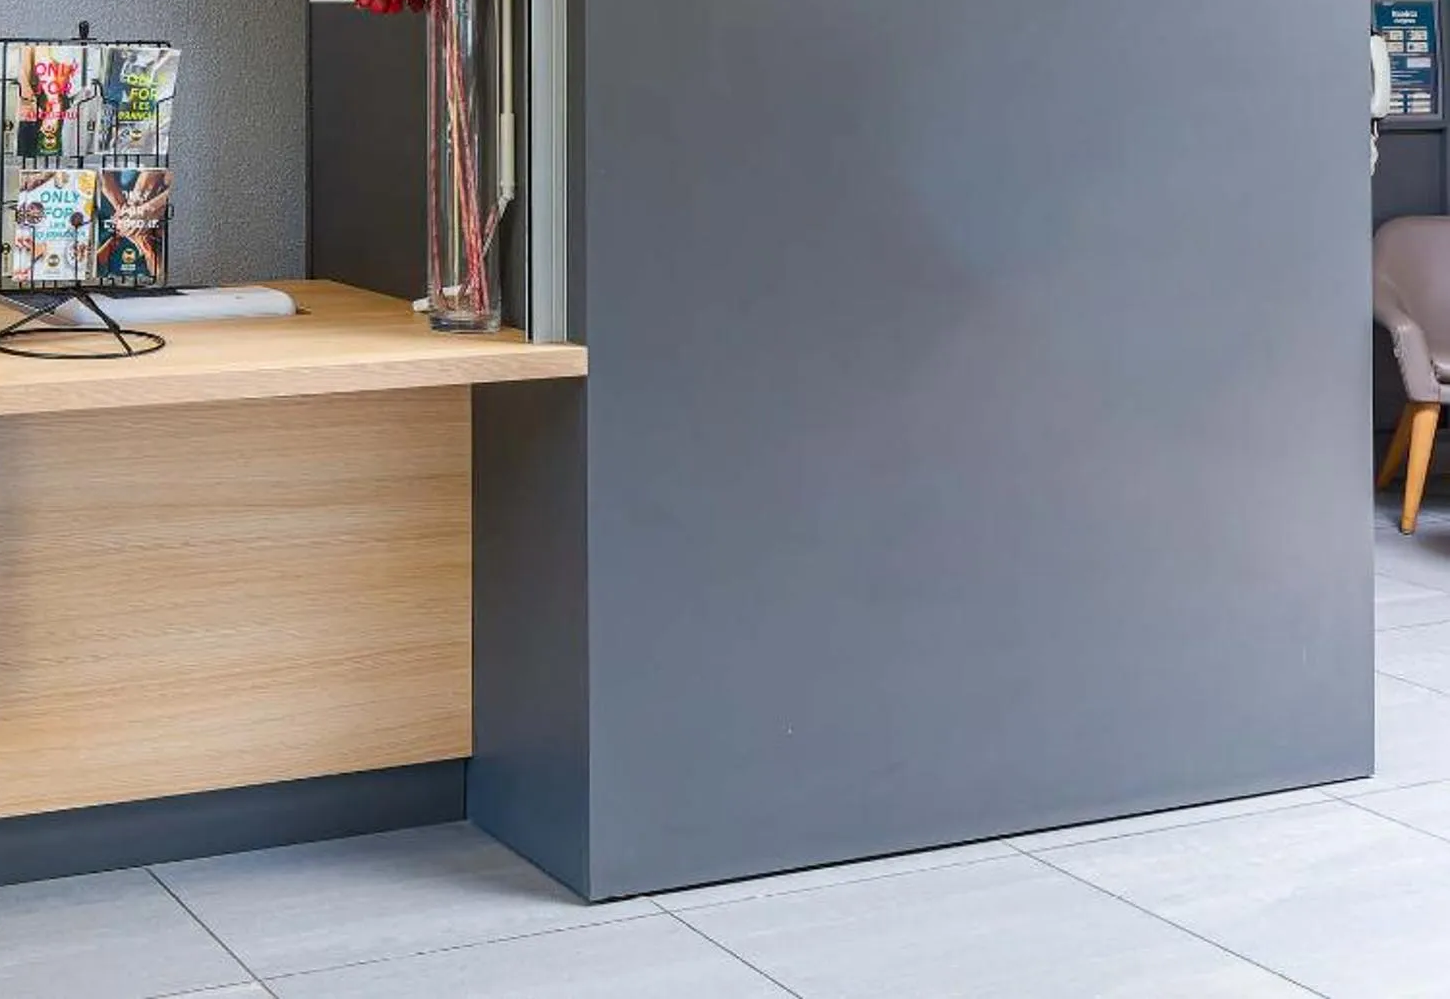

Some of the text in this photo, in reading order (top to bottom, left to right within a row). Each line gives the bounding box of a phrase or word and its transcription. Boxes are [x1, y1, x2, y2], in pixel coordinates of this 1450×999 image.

[34, 61, 79, 77] ONLY
[37, 80, 72, 94] FOR
[130, 87, 158, 100] FOR
[40, 191, 80, 204] ONLY
[45, 207, 73, 220] FOR
